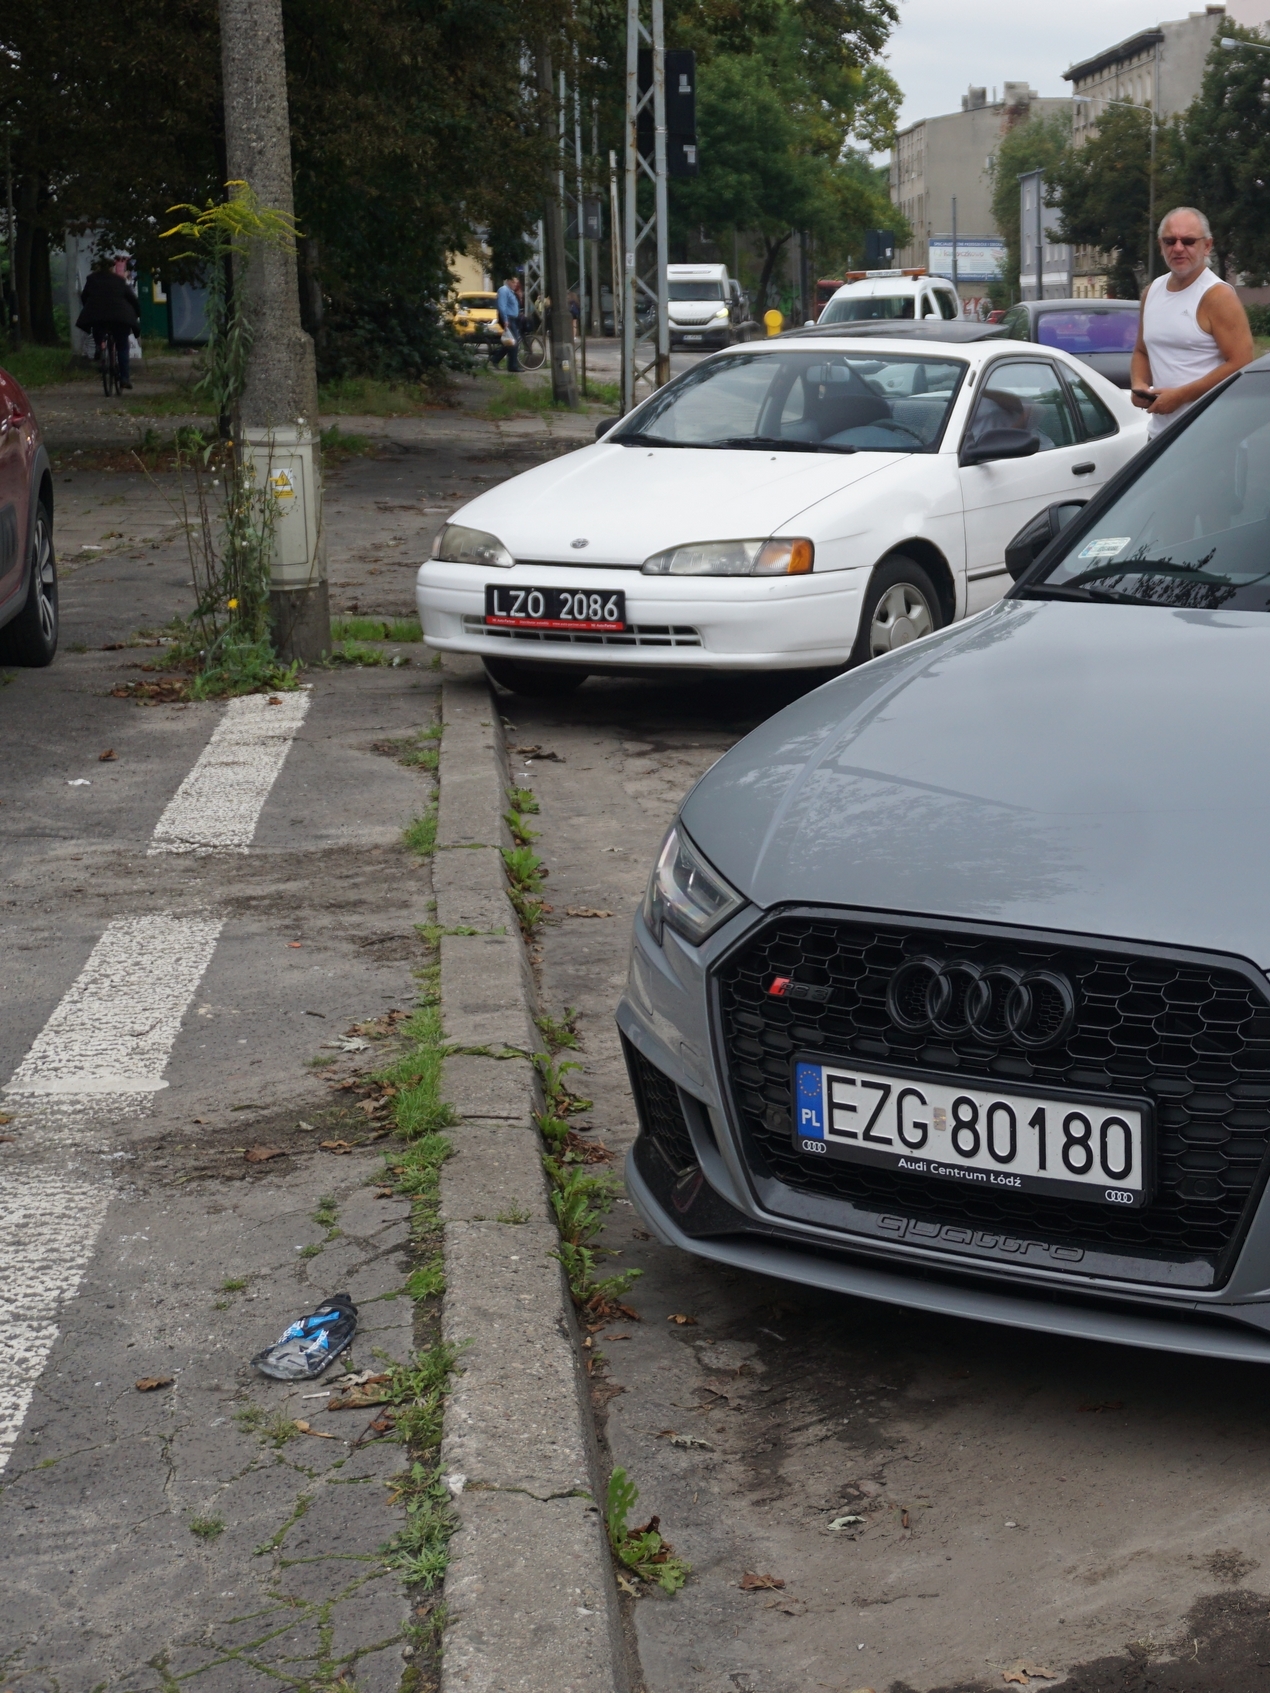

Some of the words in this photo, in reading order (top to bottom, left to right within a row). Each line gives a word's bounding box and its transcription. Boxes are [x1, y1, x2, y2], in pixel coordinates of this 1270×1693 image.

[493, 589, 544, 617] LZO
[559, 592, 618, 621] 2086
[801, 1108, 820, 1127] PL
[826, 1073, 929, 1150] EZG
[950, 1095, 1133, 1180] 80180
[897, 1157, 927, 1172] Audi
[930, 1163, 987, 1182] Centrum
[990, 1172, 1022, 1187] Łódź
[877, 1213, 1085, 1262] quattro
